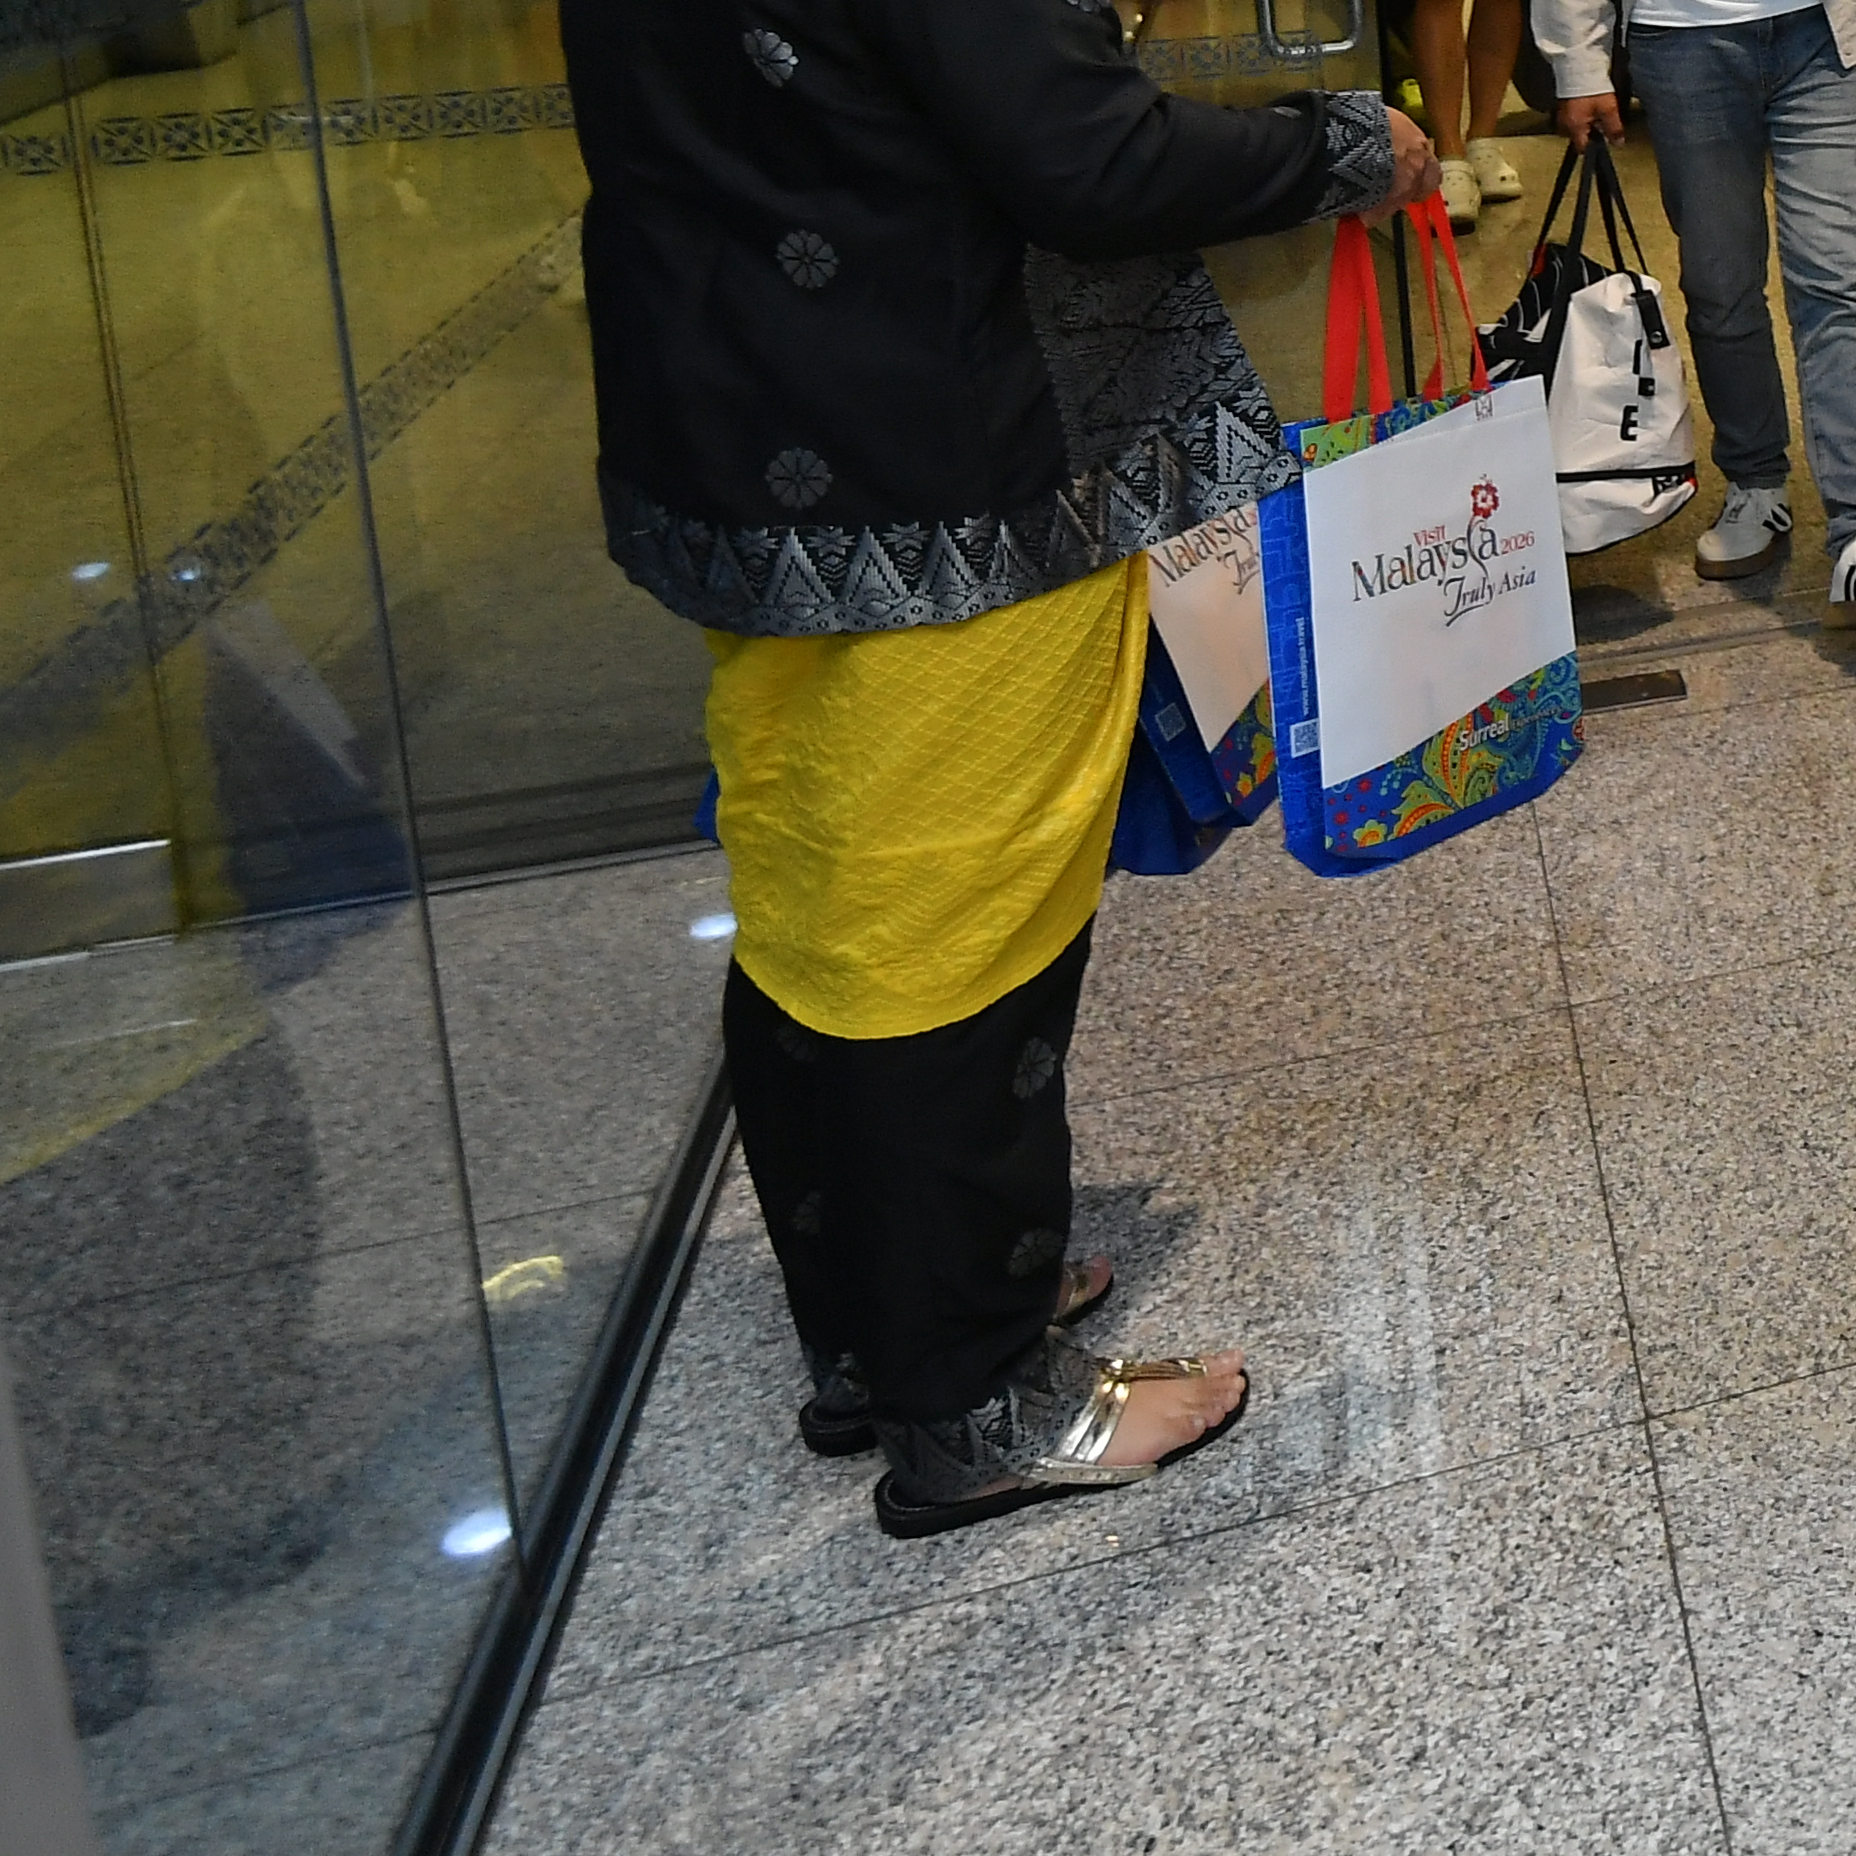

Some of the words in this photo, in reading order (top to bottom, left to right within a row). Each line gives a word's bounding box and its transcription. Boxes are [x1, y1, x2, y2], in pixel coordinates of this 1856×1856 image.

[1351, 518, 1500, 602] Malaysia
[1500, 531, 1536, 555] 2026
[1413, 525, 1446, 547] Visit
[1443, 574, 1495, 627] Truly
[1499, 565, 1537, 595] Asia
[1459, 712, 1511, 752] Surreal
